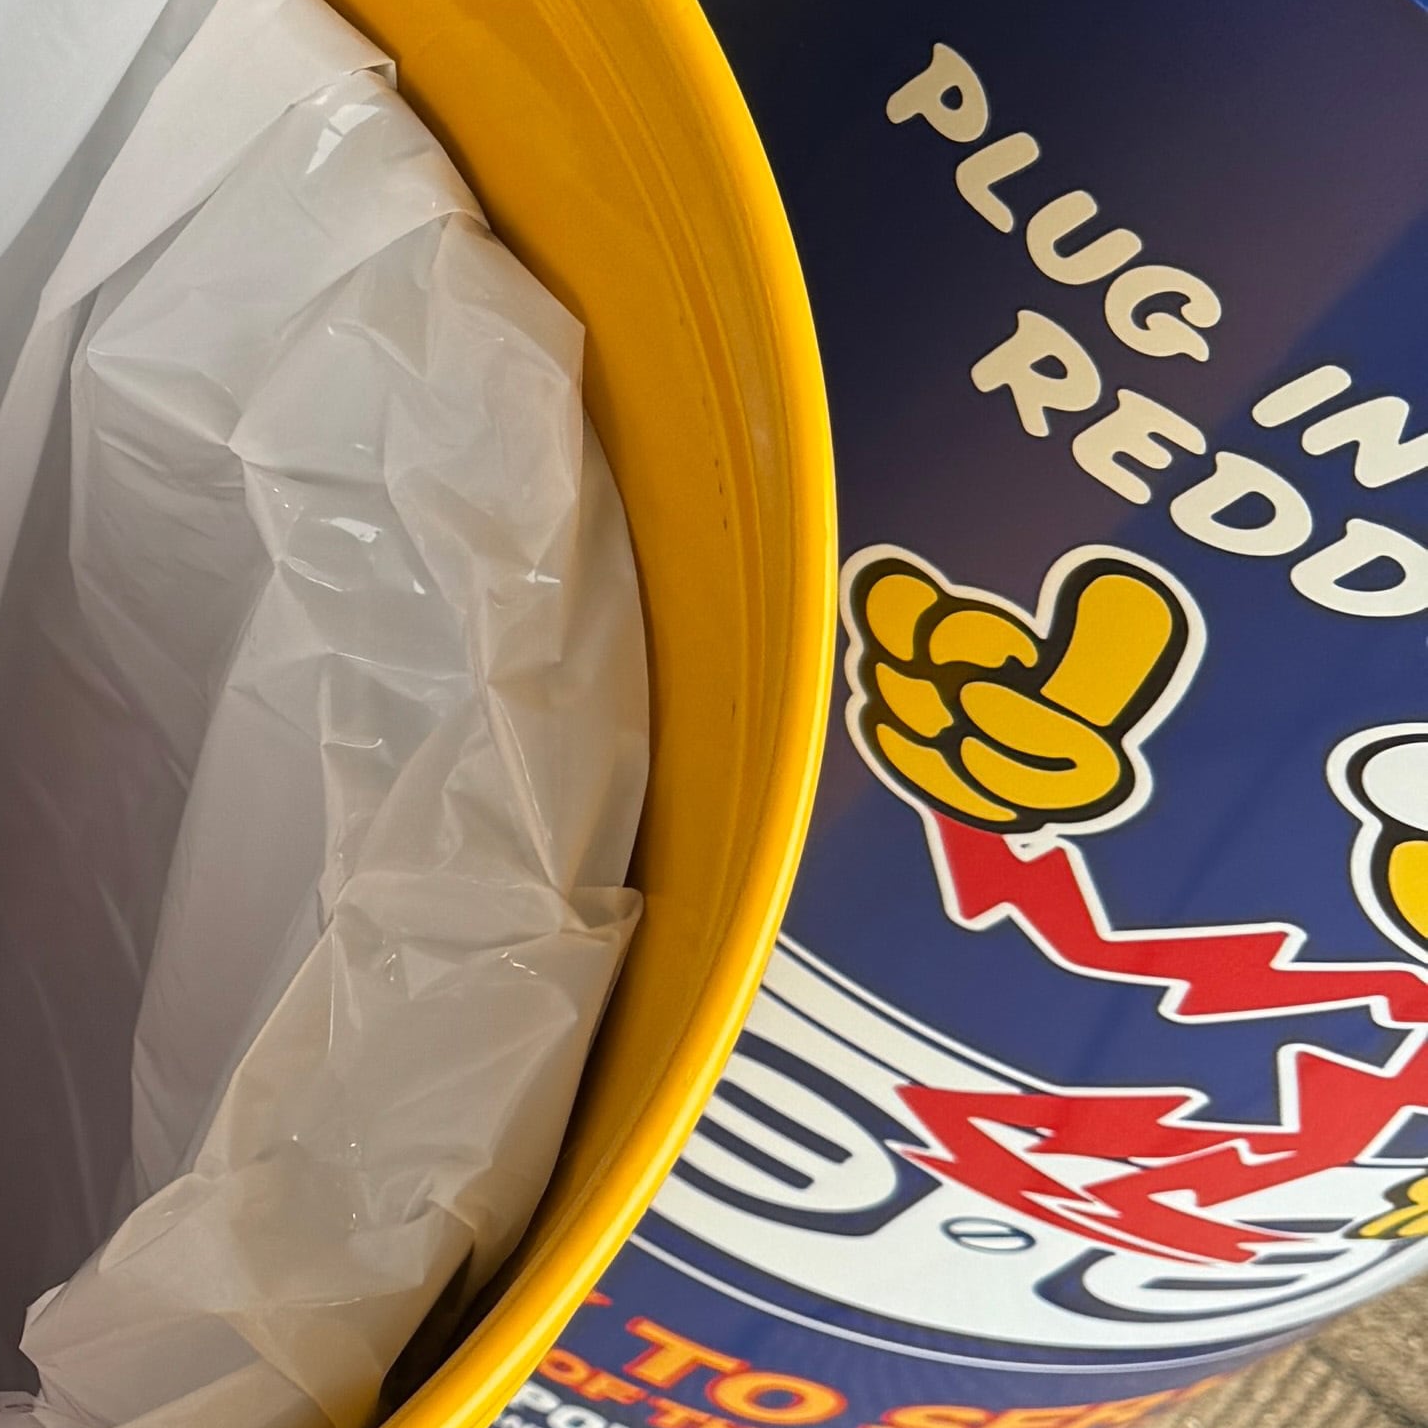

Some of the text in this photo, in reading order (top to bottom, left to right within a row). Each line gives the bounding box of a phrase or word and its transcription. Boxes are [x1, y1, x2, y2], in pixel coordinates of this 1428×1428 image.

[885, 42, 1224, 363] PLUG
[970, 309, 1428, 619] REDD
[537, 1348, 647, 1405] OF
[623, 1316, 848, 1426] TO
